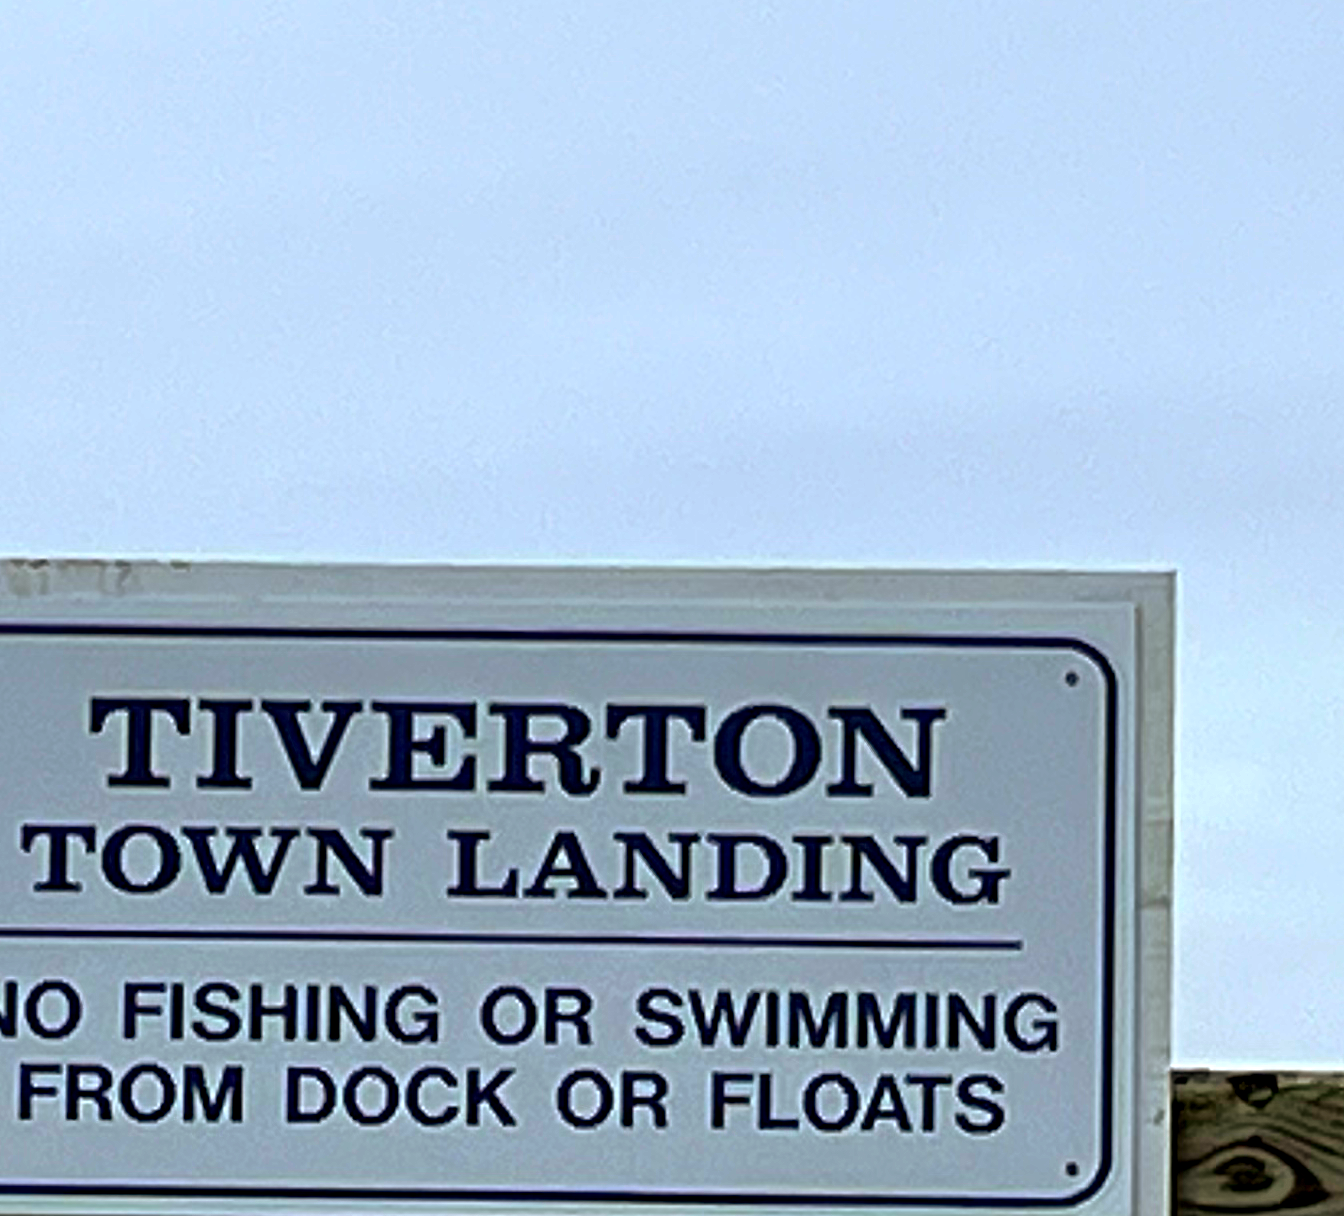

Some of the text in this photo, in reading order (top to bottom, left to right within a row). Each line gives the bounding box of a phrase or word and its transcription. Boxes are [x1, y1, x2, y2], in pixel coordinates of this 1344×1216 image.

[87, 695, 949, 800] TIVERTON
[19, 822, 1013, 907] TOWN LANDING
[122, 980, 440, 1046] FISHING
[479, 984, 594, 1047] OR
[633, 986, 1060, 1054] SWIMMING
[17, 1061, 1006, 1136] FROM DOCK OR FLOATS
